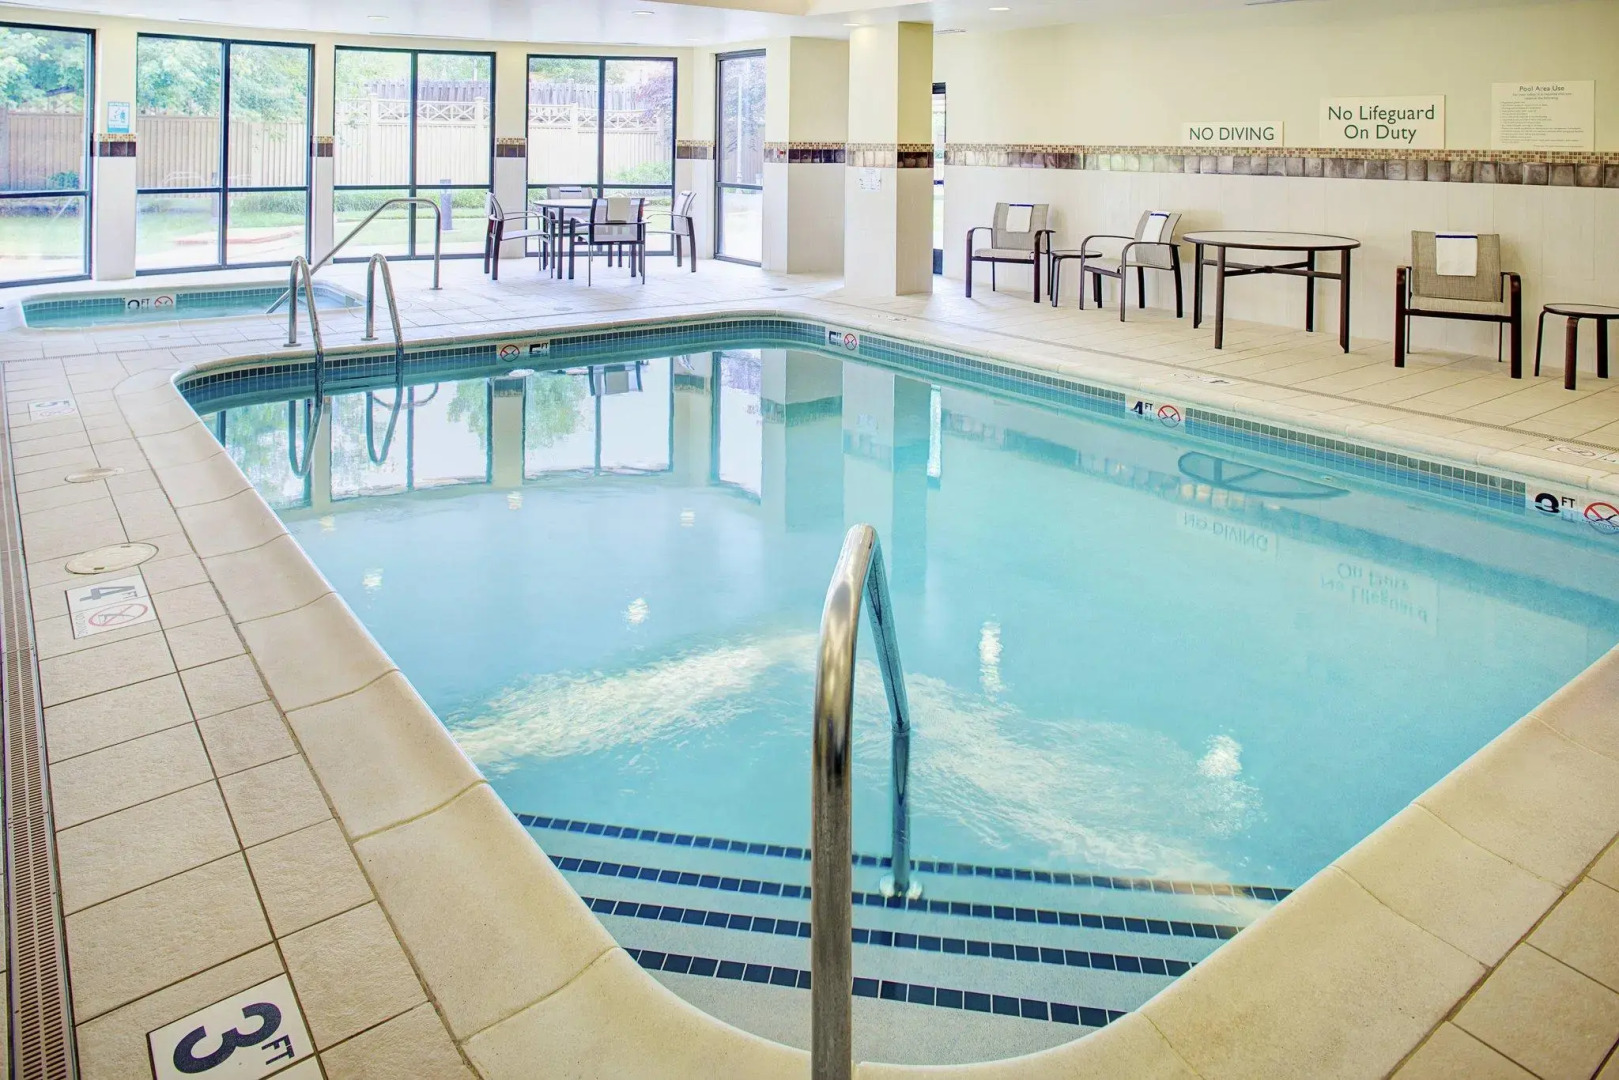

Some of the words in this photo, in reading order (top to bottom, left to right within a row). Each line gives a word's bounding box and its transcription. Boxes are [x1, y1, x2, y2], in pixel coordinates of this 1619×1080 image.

[1328, 106, 1353, 120] No
[1359, 105, 1435, 125] Lifeguard
[1189, 127, 1214, 141] NO
[1219, 126, 1275, 141] DIVING
[1343, 124, 1369, 139] On
[1375, 124, 1417, 143] Duty
[1562, 496, 1576, 508] FT
[80, 585, 135, 601] 4
[173, 1002, 282, 1074] 3
[261, 1034, 295, 1065] FT
